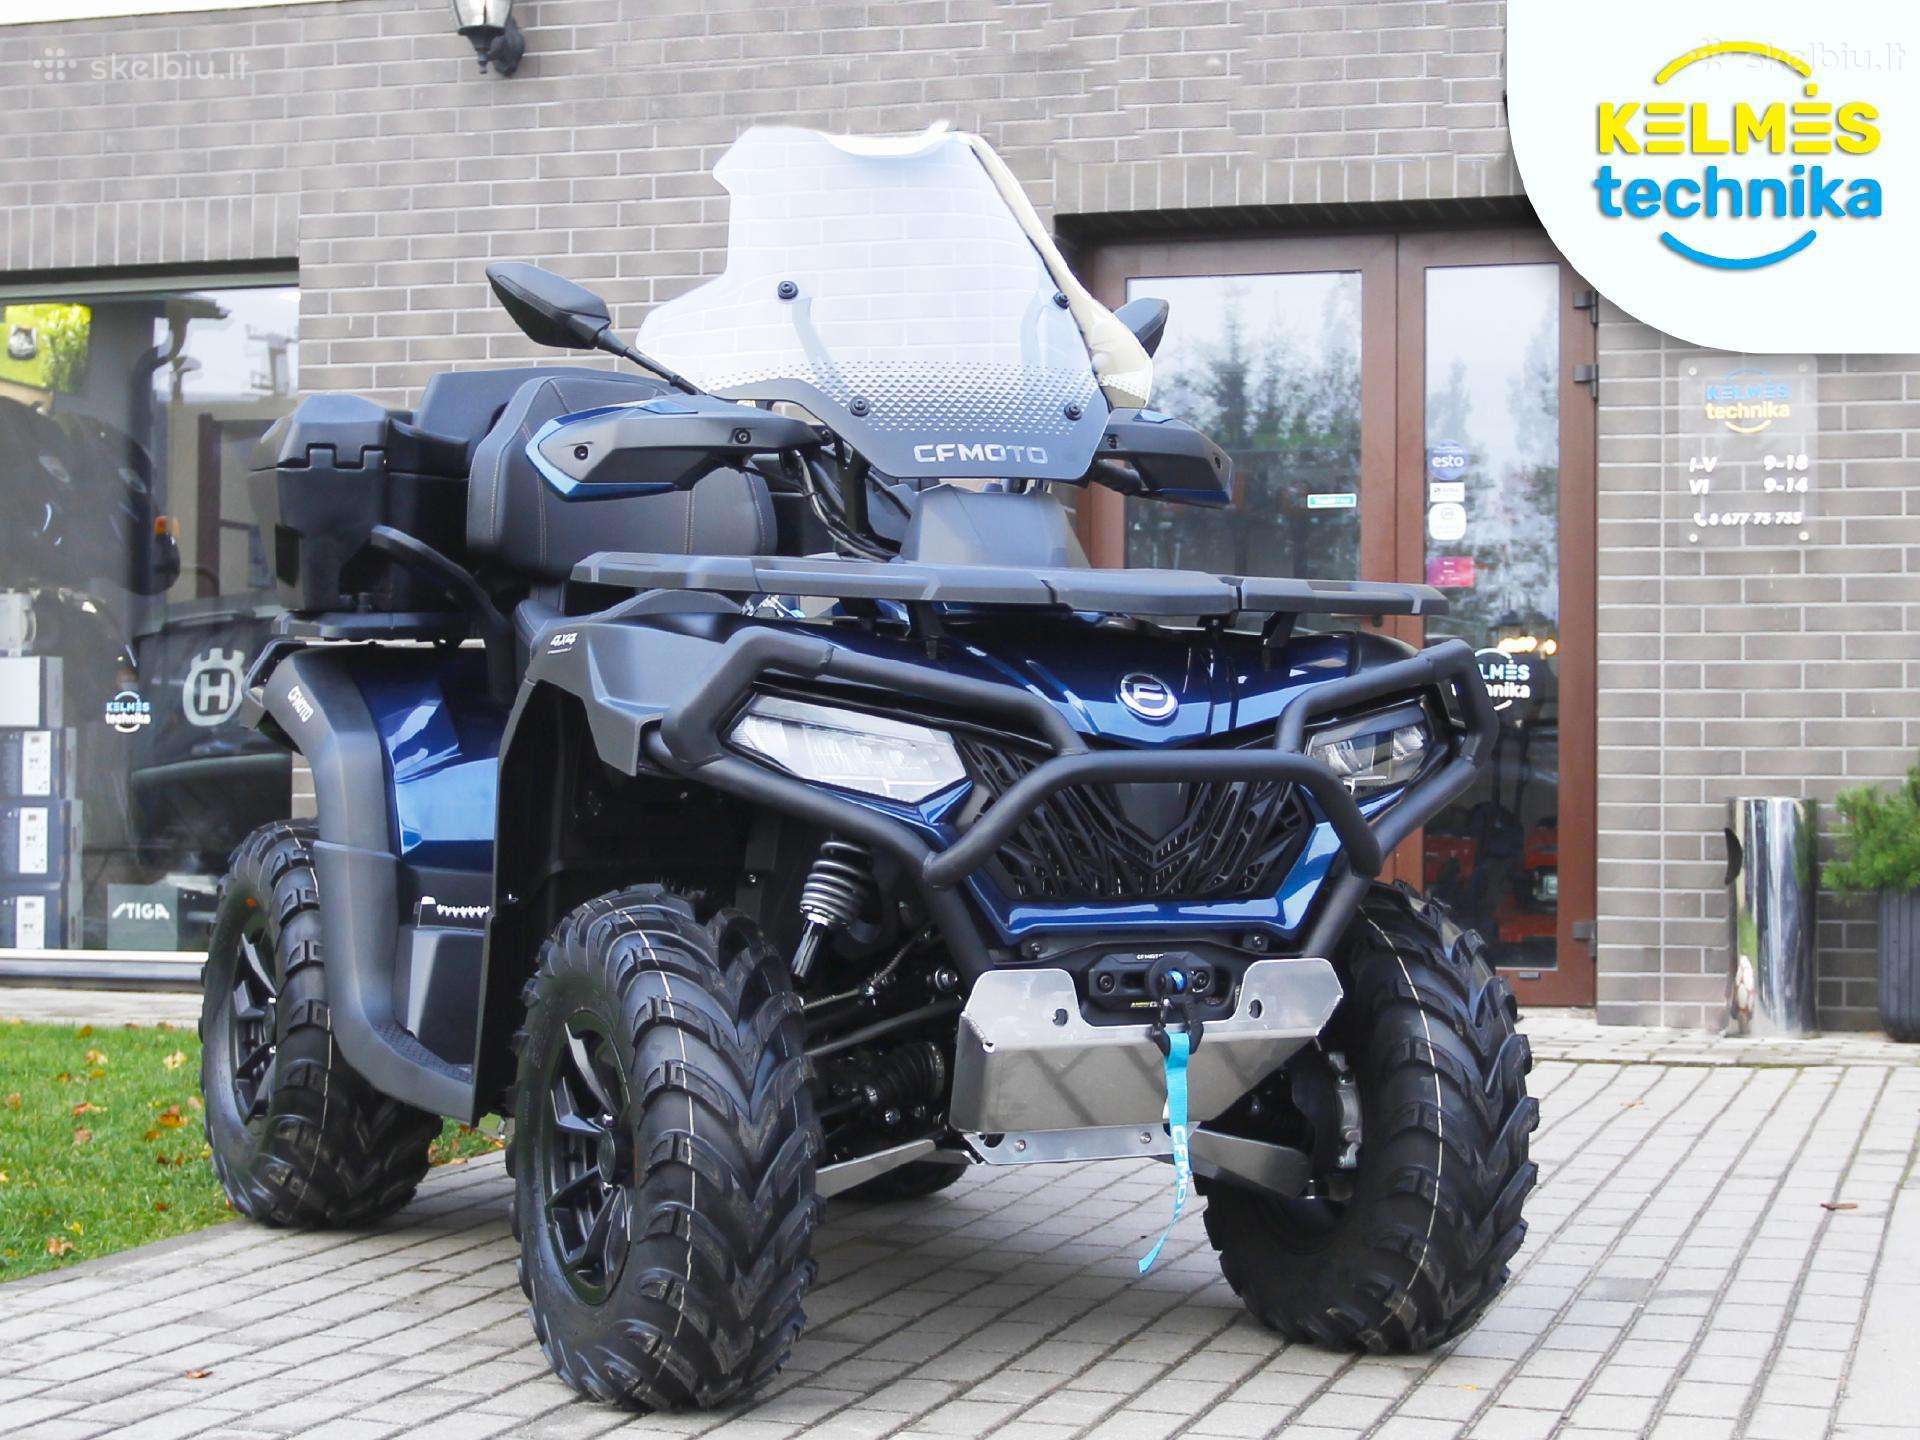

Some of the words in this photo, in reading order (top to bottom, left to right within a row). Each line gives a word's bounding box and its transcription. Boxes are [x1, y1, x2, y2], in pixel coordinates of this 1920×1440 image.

[1705, 401, 1790, 420] technika
[913, 443, 1049, 464] CFMOTO
[1432, 455, 1465, 468] esto
[1763, 454, 1809, 471] 9-18
[1763, 477, 1809, 493] 9-14
[1478, 659, 1530, 680] LMĖS
